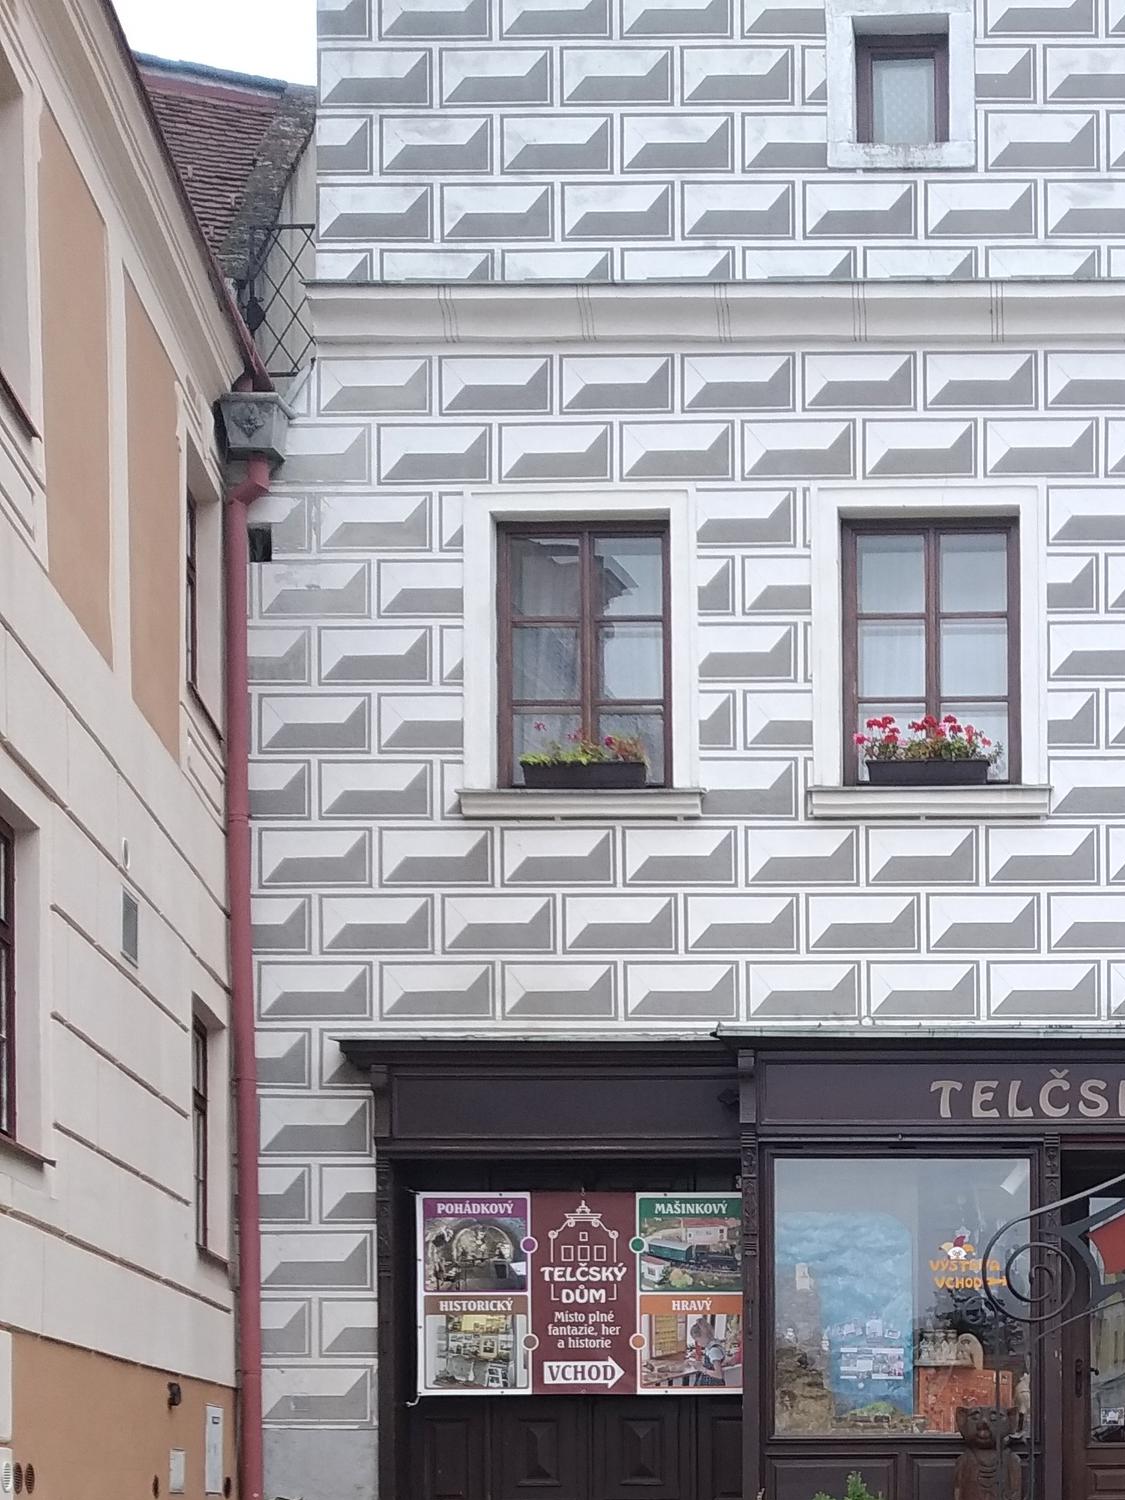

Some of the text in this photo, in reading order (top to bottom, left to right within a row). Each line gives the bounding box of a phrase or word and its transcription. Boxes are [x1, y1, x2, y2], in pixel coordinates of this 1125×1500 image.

[436, 1200, 514, 1215] POHÁDKOVÝ
[654, 1200, 728, 1215] MAŠINKOVÝ
[540, 1262, 627, 1282] TELČSKÝ
[934, 1276, 983, 1289] VCHOD
[561, 1284, 607, 1304] DŮM
[439, 1297, 514, 1312] HISTORICKÝ
[671, 1297, 712, 1312] HRAVÝ
[554, 1310, 615, 1325] Místo plné
[547, 1323, 621, 1336] fantazie, her
[556, 1337, 612, 1349] a historie
[547, 1364, 616, 1381] VCHOD
